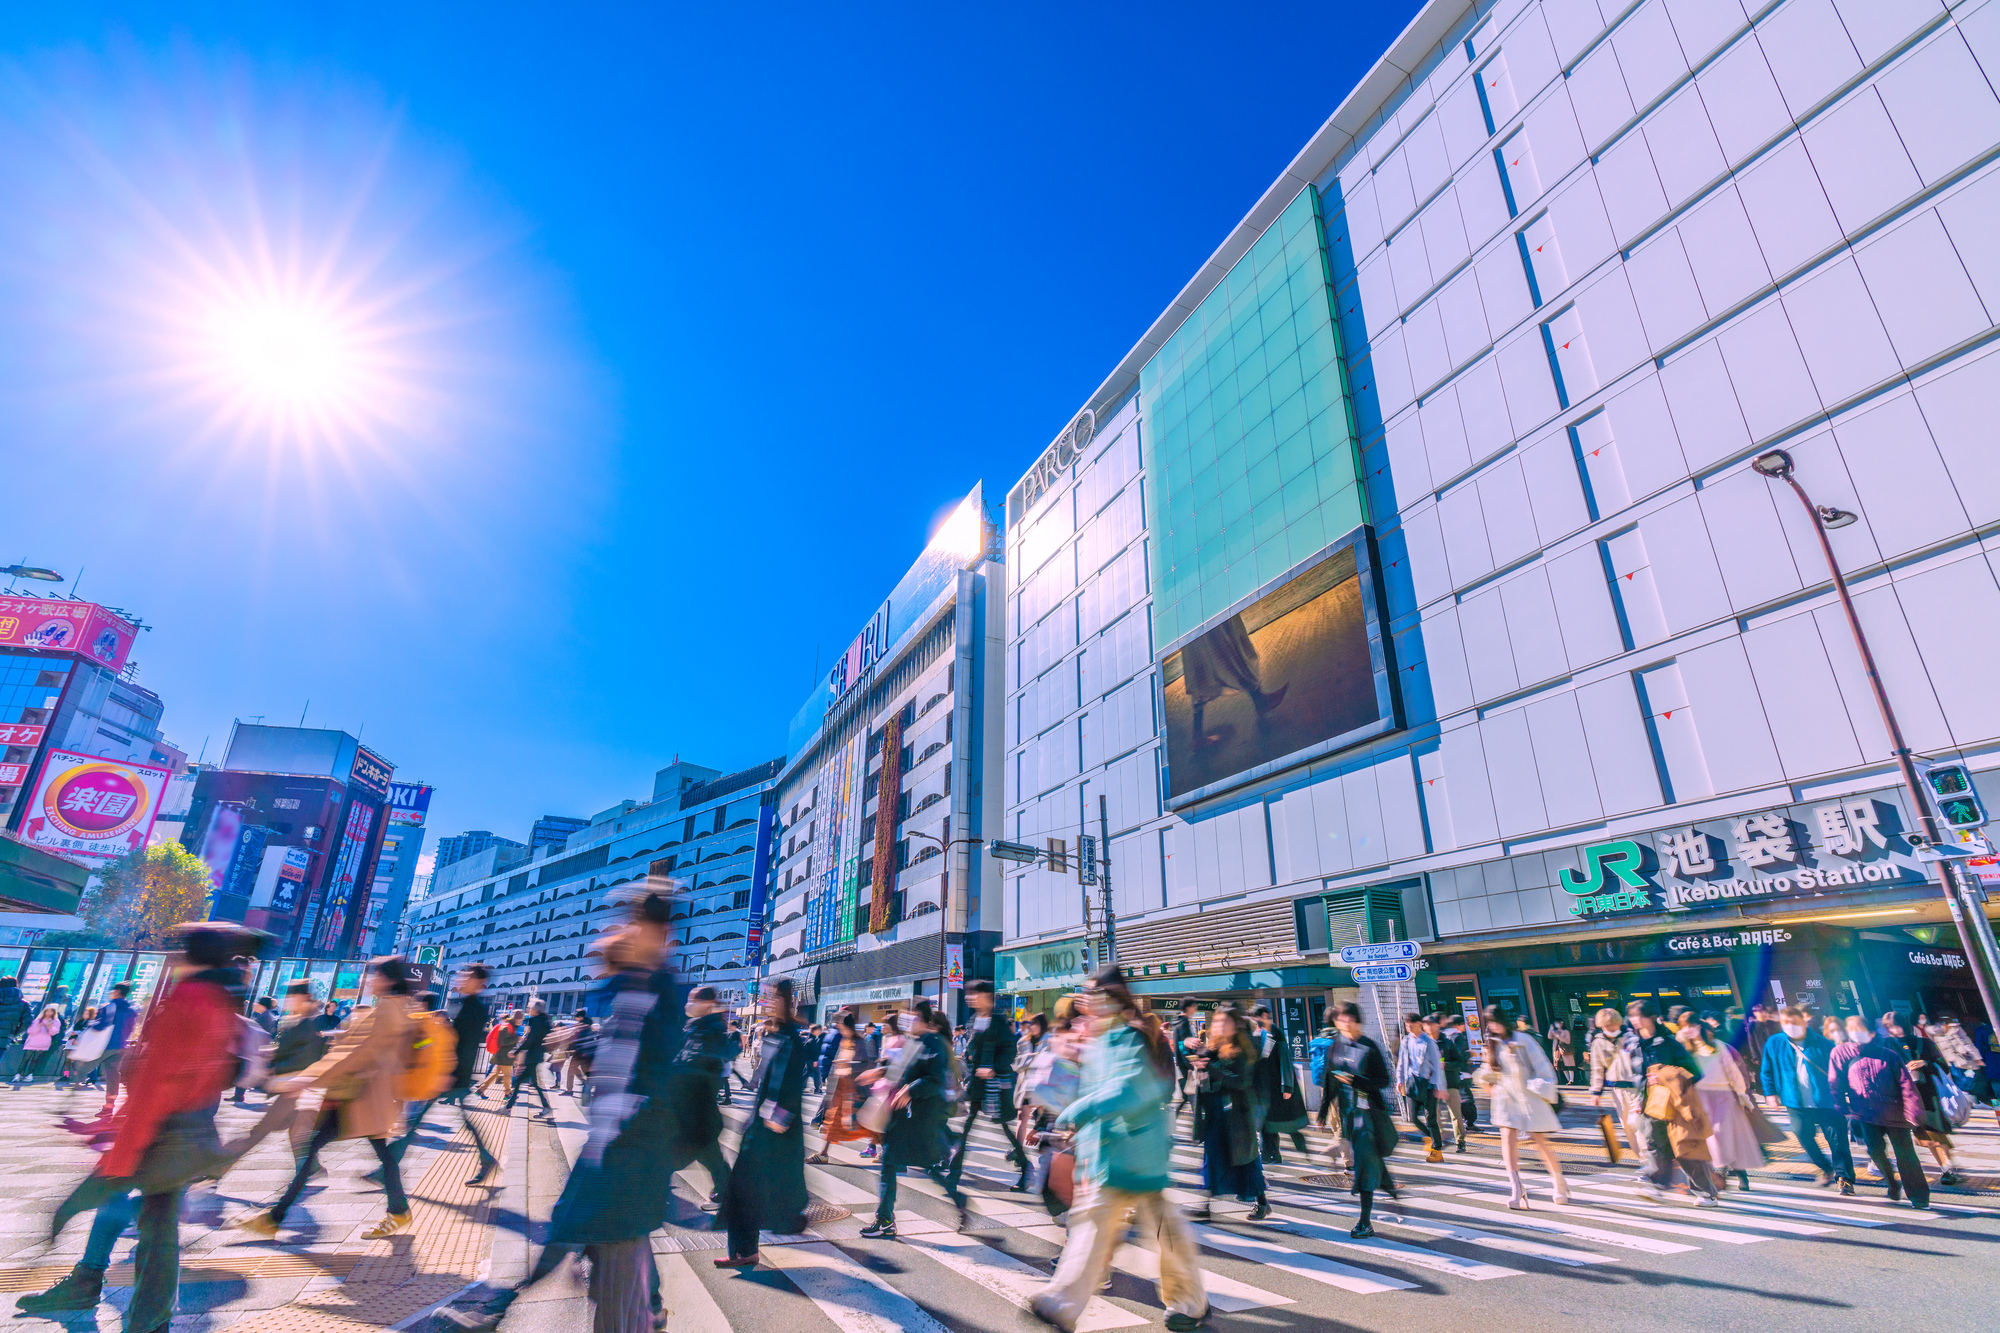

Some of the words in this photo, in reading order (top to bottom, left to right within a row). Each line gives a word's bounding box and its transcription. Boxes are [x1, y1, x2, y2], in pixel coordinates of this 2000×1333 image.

[1022, 408, 1096, 516] PARCO
[52, 753, 84, 764] パチンコ
[137, 768, 165, 779] スロット
[356, 757, 390, 786] ドンキホーテ
[60, 786, 137, 818] 楽園
[45, 806, 77, 835] EXCITING
[80, 818, 138, 840] AMUSEMENT
[36, 836, 84, 850] ビル裏側
[1659, 798, 1888, 877] 池袋駅
[1558, 840, 1650, 896] JR
[1669, 877, 1791, 904] Ikebukuro
[1795, 862, 1901, 890] Station
[1568, 889, 1651, 915] JR東日本
[1668, 937, 1700, 950] Café
[1701, 938, 1712, 949] &
[1713, 935, 1739, 948] Bar
[1739, 929, 1786, 946] RAGE
[1041, 950, 1075, 973] PARCO
[1908, 951, 1926, 964] Café
[1925, 954, 1931, 965] &
[1930, 953, 1943, 965] Bar
[869, 989, 882, 1000] LOUIS
[883, 987, 902, 999] VUITTON
[1165, 1001, 1178, 1009] ISP
